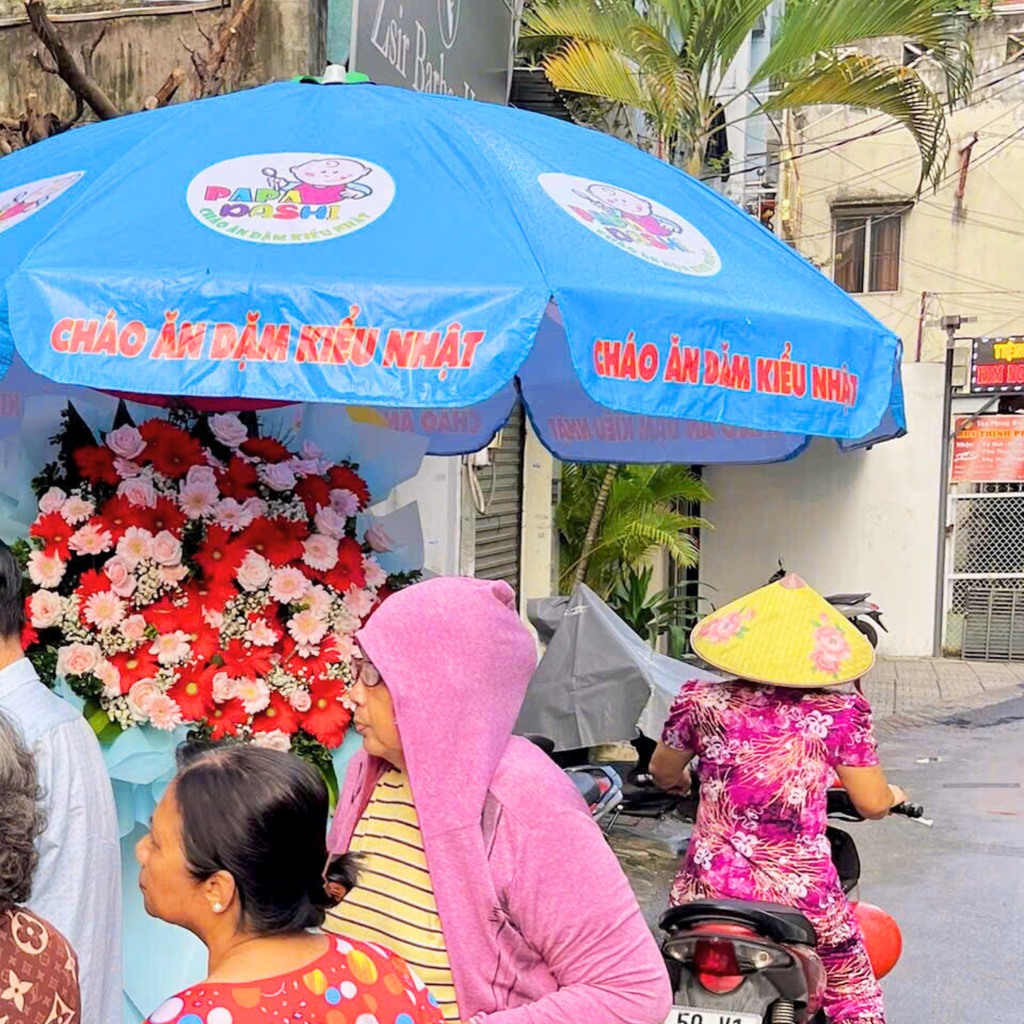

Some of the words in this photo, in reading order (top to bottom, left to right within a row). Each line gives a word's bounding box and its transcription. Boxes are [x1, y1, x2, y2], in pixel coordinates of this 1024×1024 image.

[204, 186, 303, 204] PAPA
[219, 203, 342, 220] DASHI
[50, 308, 147, 358] CHÁO
[149, 309, 207, 360] ĂN
[208, 310, 291, 372] DẶM
[294, 304, 380, 366] KIỂU
[381, 321, 487, 381] NHẬT
[593, 331, 659, 383] CHÁO
[663, 333, 700, 385] ĂN
[756, 341, 806, 397] KIỂU
